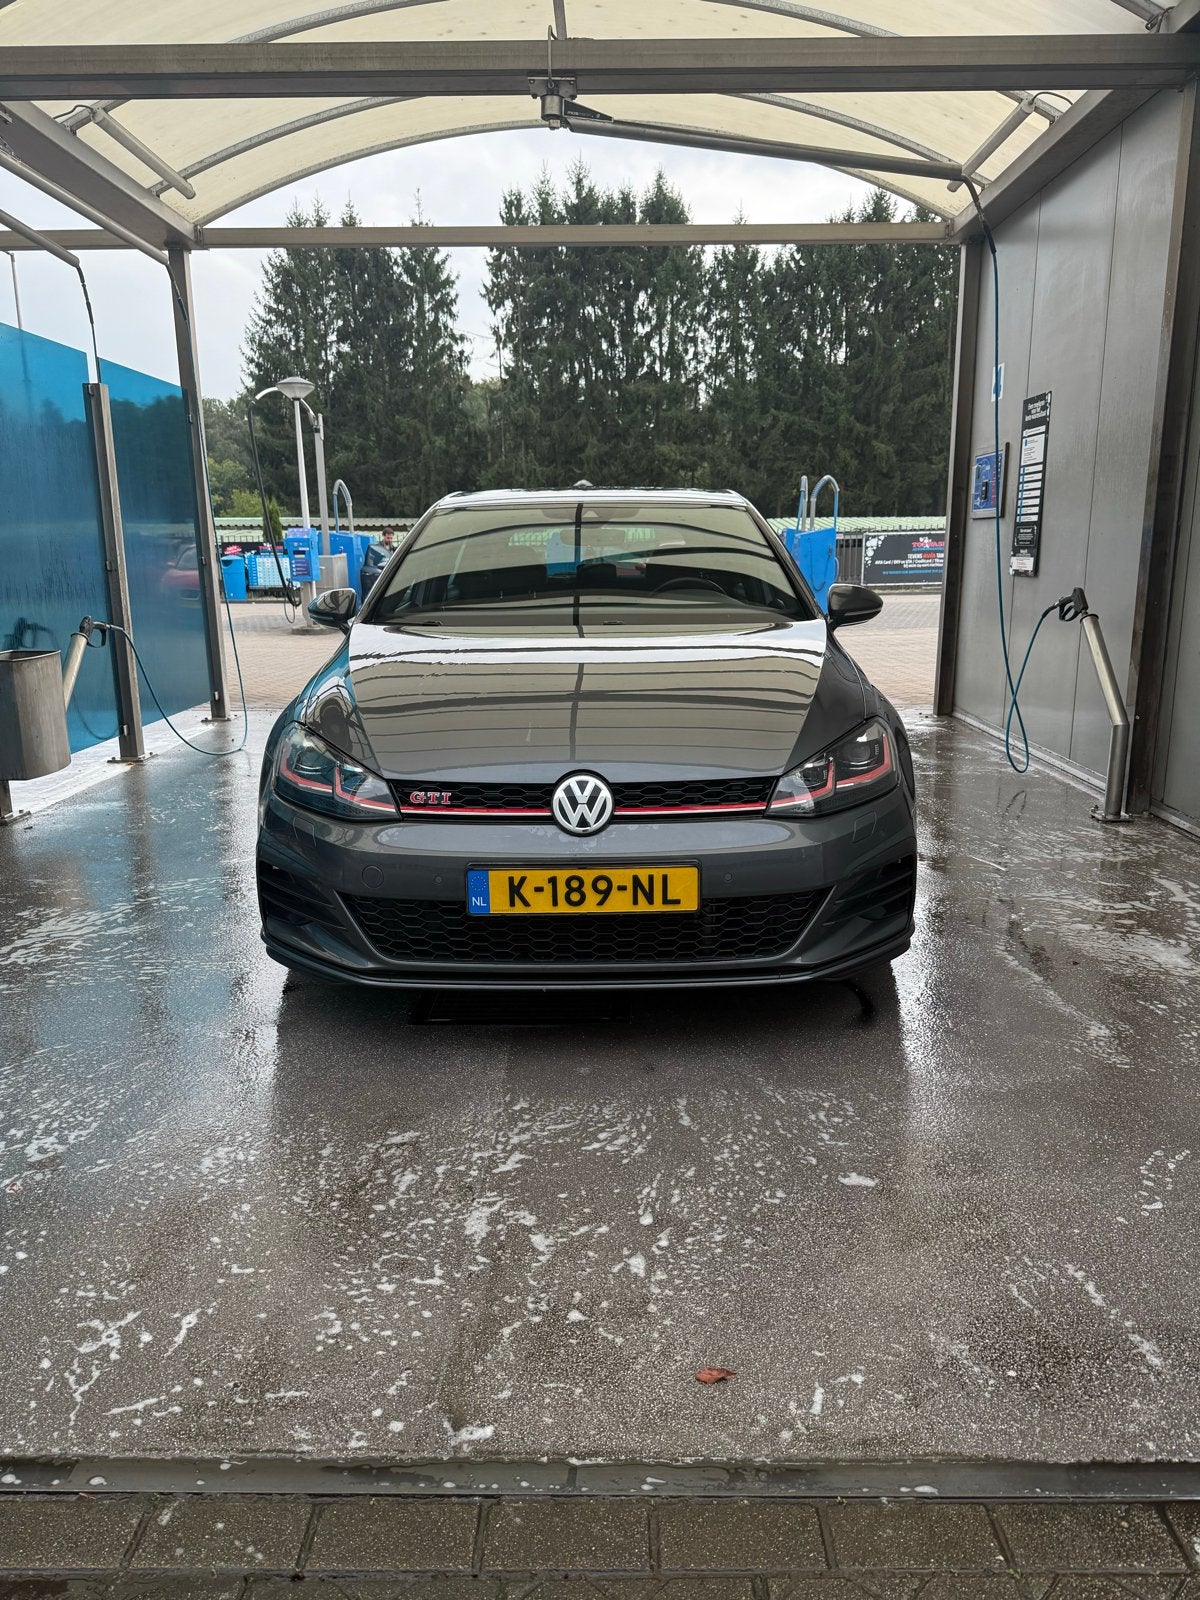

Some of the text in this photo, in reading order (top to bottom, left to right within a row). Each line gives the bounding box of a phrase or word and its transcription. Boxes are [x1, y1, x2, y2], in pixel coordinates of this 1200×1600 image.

[409, 790, 452, 805] GTI
[555, 775, 611, 832] VW
[471, 896, 487, 907] NL
[507, 873, 682, 908] K-189-NL
